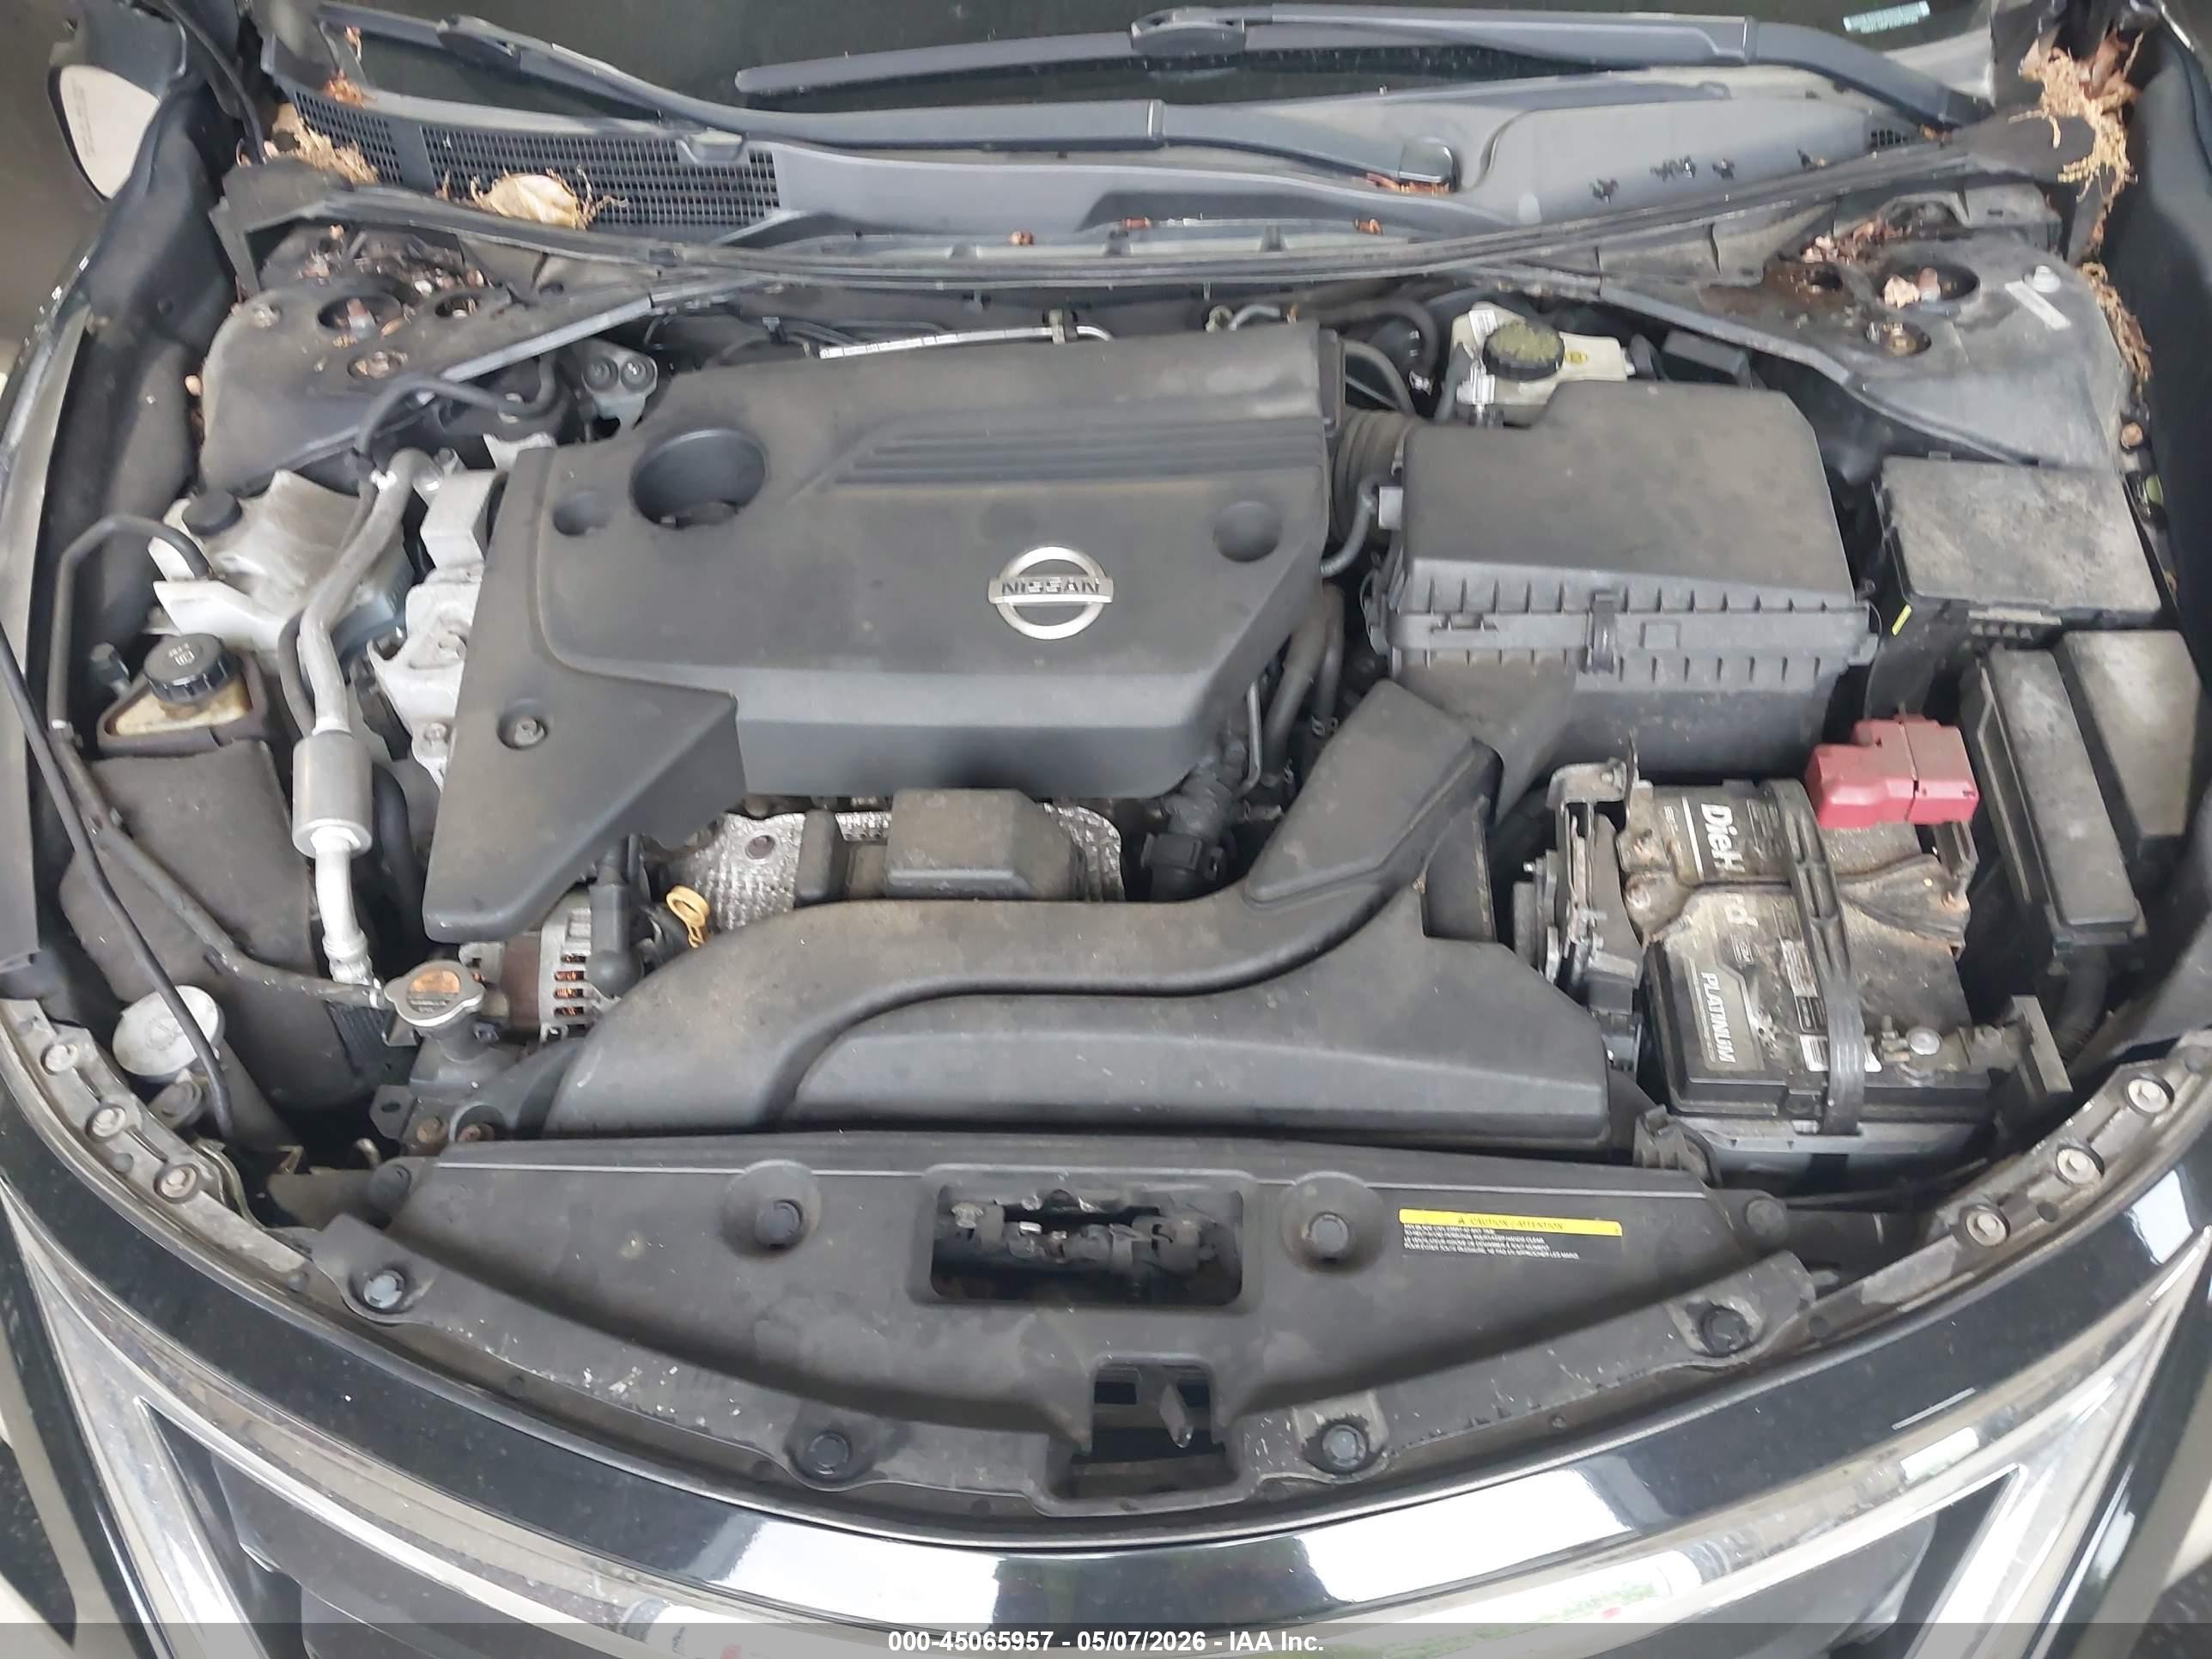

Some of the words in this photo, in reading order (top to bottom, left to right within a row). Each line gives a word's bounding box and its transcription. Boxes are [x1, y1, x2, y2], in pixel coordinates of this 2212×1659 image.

[1001, 578, 1100, 594] NISSAN
[1701, 803, 1759, 927] DieHrd
[1700, 971, 1737, 1064] PLATINUM
